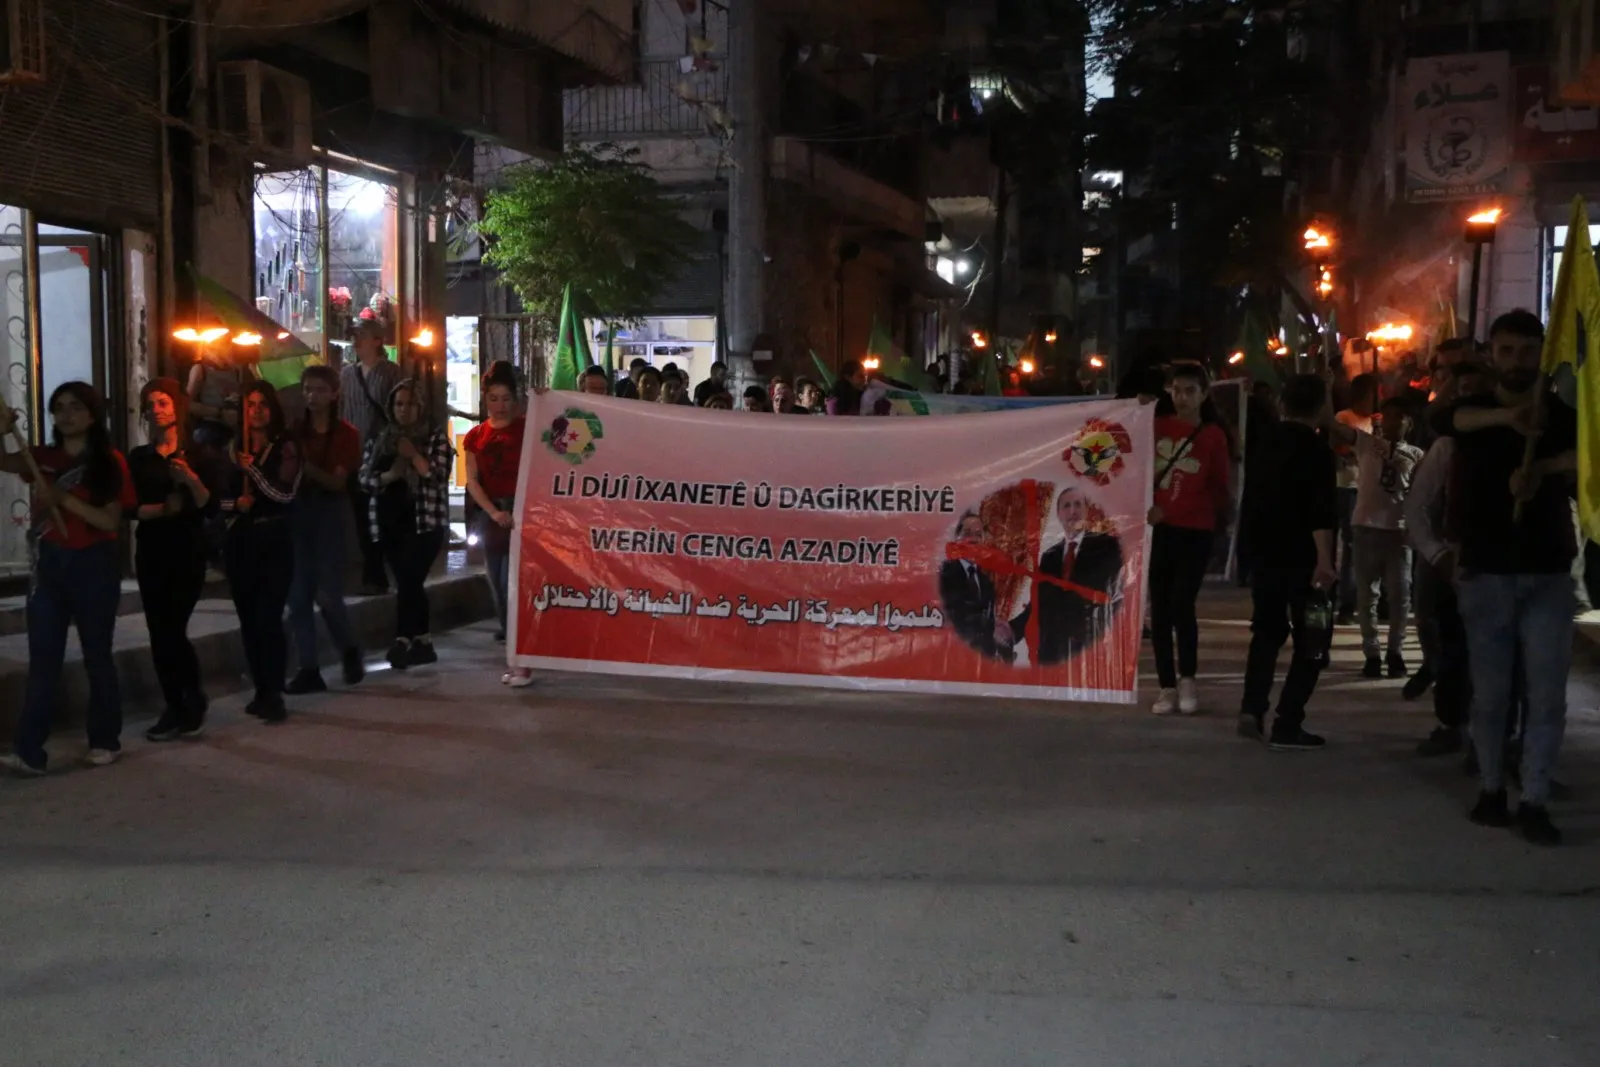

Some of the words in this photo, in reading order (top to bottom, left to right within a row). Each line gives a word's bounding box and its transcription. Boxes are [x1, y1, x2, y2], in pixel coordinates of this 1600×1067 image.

[634, 474, 748, 507] ÎXANETÊ
[753, 481, 772, 508] Û
[682, 532, 773, 561] CENGA
[533, 583, 619, 616] والاحتلال
[623, 587, 692, 619] الخيانة
[696, 594, 732, 618] ضد
[736, 594, 800, 625] الحرية
[804, 599, 879, 631] لمعركة
[884, 601, 944, 632] هلموا
